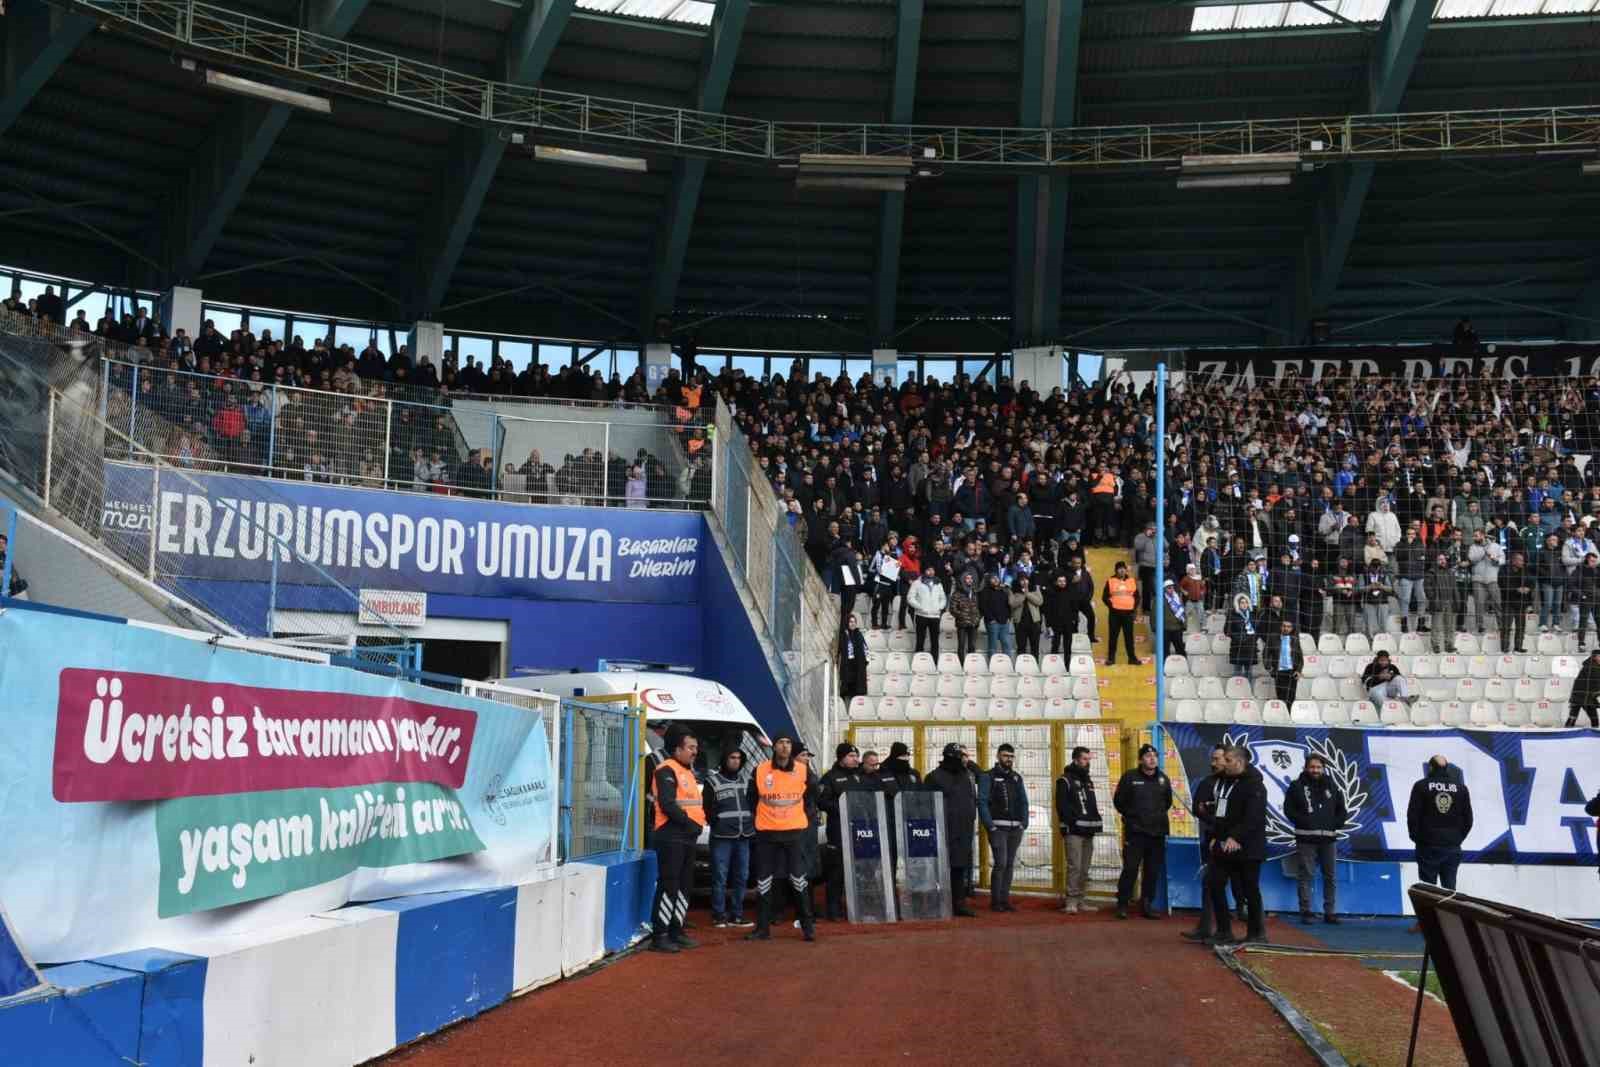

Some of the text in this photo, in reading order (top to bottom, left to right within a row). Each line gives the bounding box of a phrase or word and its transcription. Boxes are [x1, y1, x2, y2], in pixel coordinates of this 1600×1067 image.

[104, 500, 153, 513] MEHMET
[158, 491, 613, 582] ERZURUMSPOR'UMUZA
[366, 598, 423, 618] AMBULANS
[83, 676, 249, 764] Ücretsiz
[252, 705, 394, 758] taramanı
[177, 813, 314, 895] yaşam
